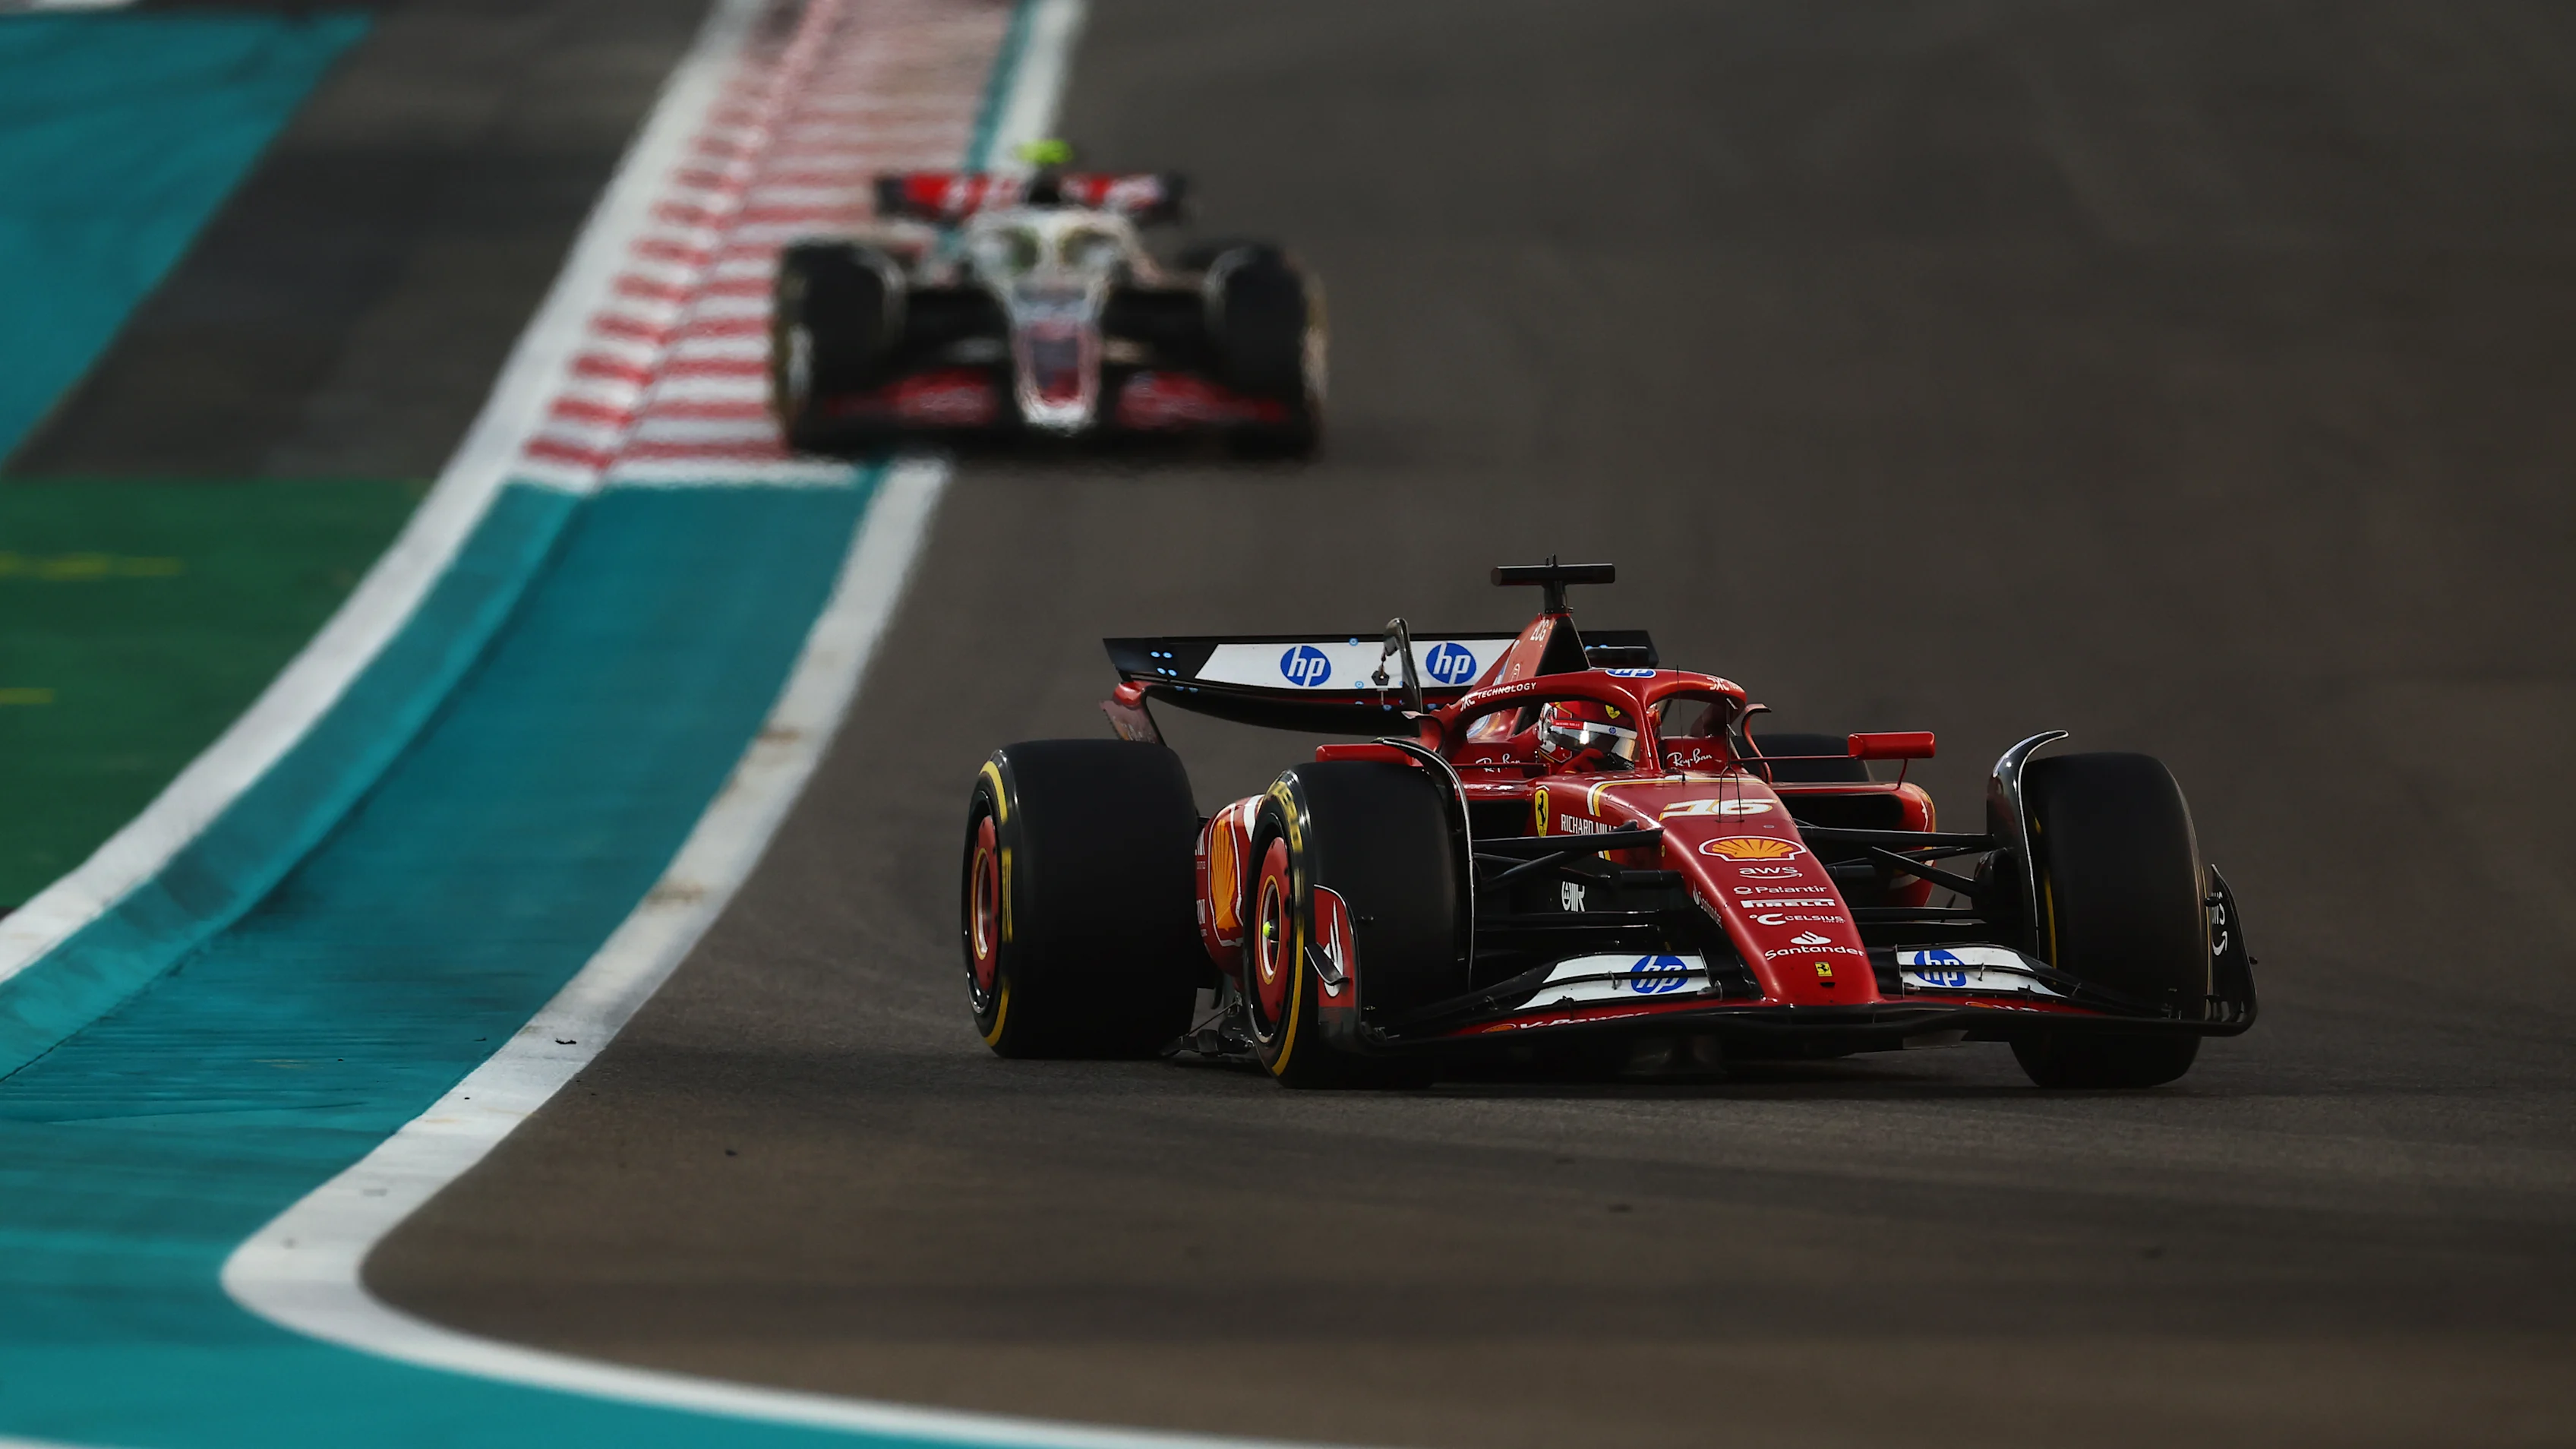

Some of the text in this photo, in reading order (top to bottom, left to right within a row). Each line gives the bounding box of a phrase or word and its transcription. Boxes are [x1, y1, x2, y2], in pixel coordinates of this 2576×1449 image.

[1286, 646, 1326, 687] hp
[1432, 642, 1472, 683] hp
[1477, 682, 1536, 699] TECHNOLOGY
[1659, 799, 1778, 822] 16
[1561, 813, 1594, 835] RICHARD
[1739, 867, 1799, 875] aws
[1755, 886, 1827, 894] Palantir
[1741, 898, 1836, 908] PIRELLI
[1764, 945, 1864, 961] Santander
[1635, 955, 1684, 994] hp
[1923, 950, 1960, 987] hp
